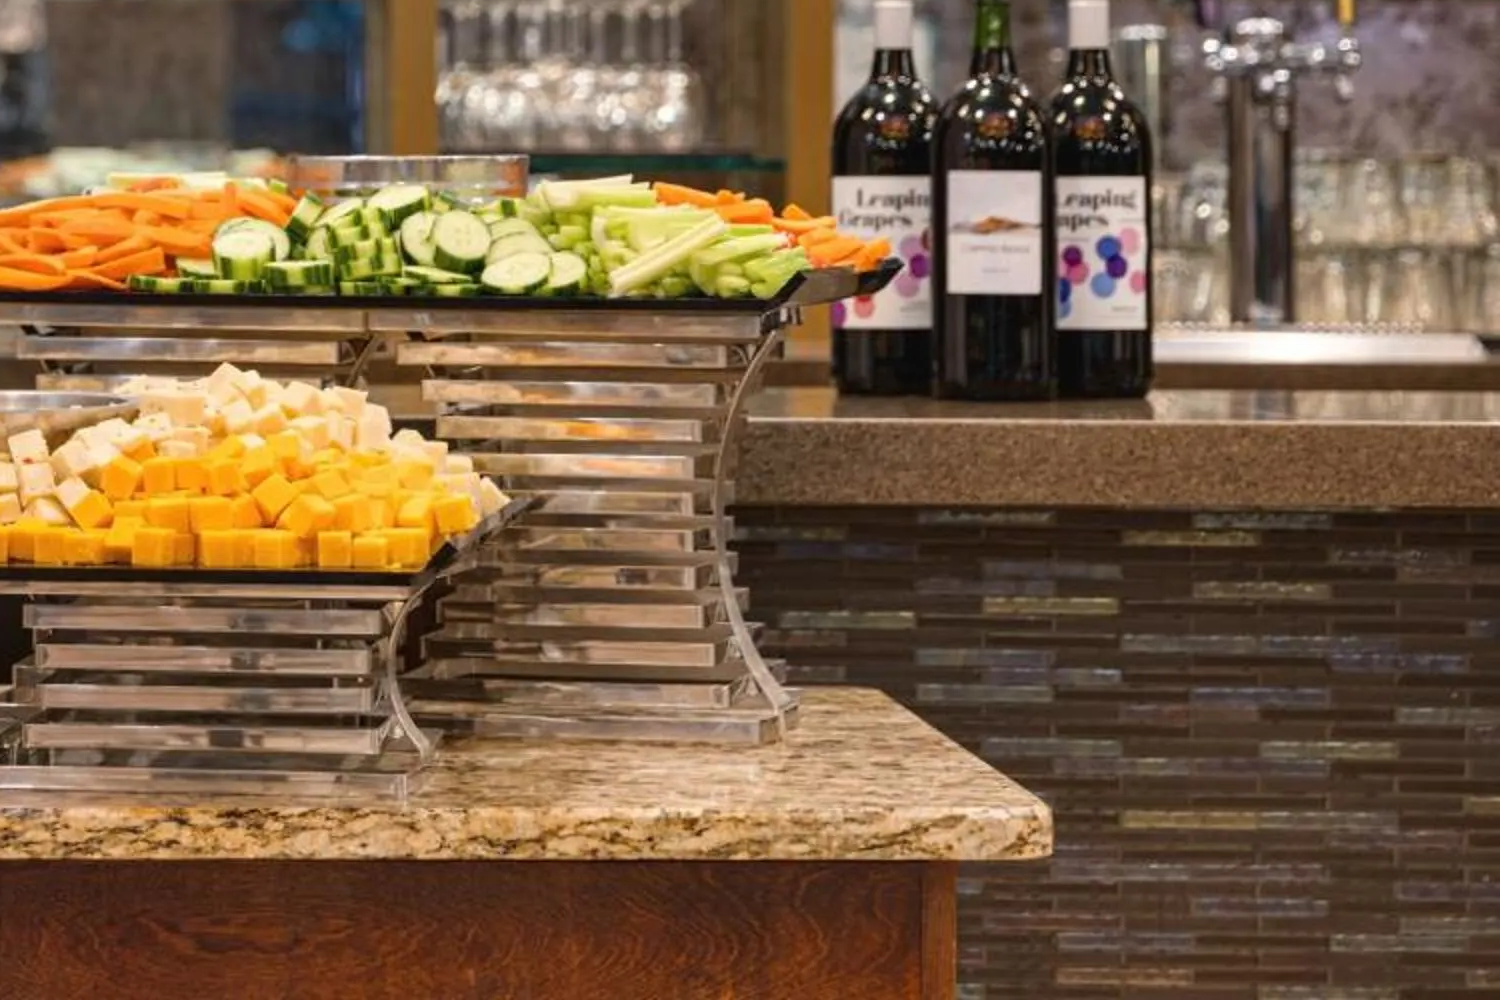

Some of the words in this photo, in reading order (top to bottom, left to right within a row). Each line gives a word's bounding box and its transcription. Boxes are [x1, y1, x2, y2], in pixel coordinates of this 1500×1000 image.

[855, 188, 930, 212] Leapin
[1057, 188, 1138, 213] eaping
[838, 208, 913, 231] Grapes
[1055, 211, 1110, 232] apes
